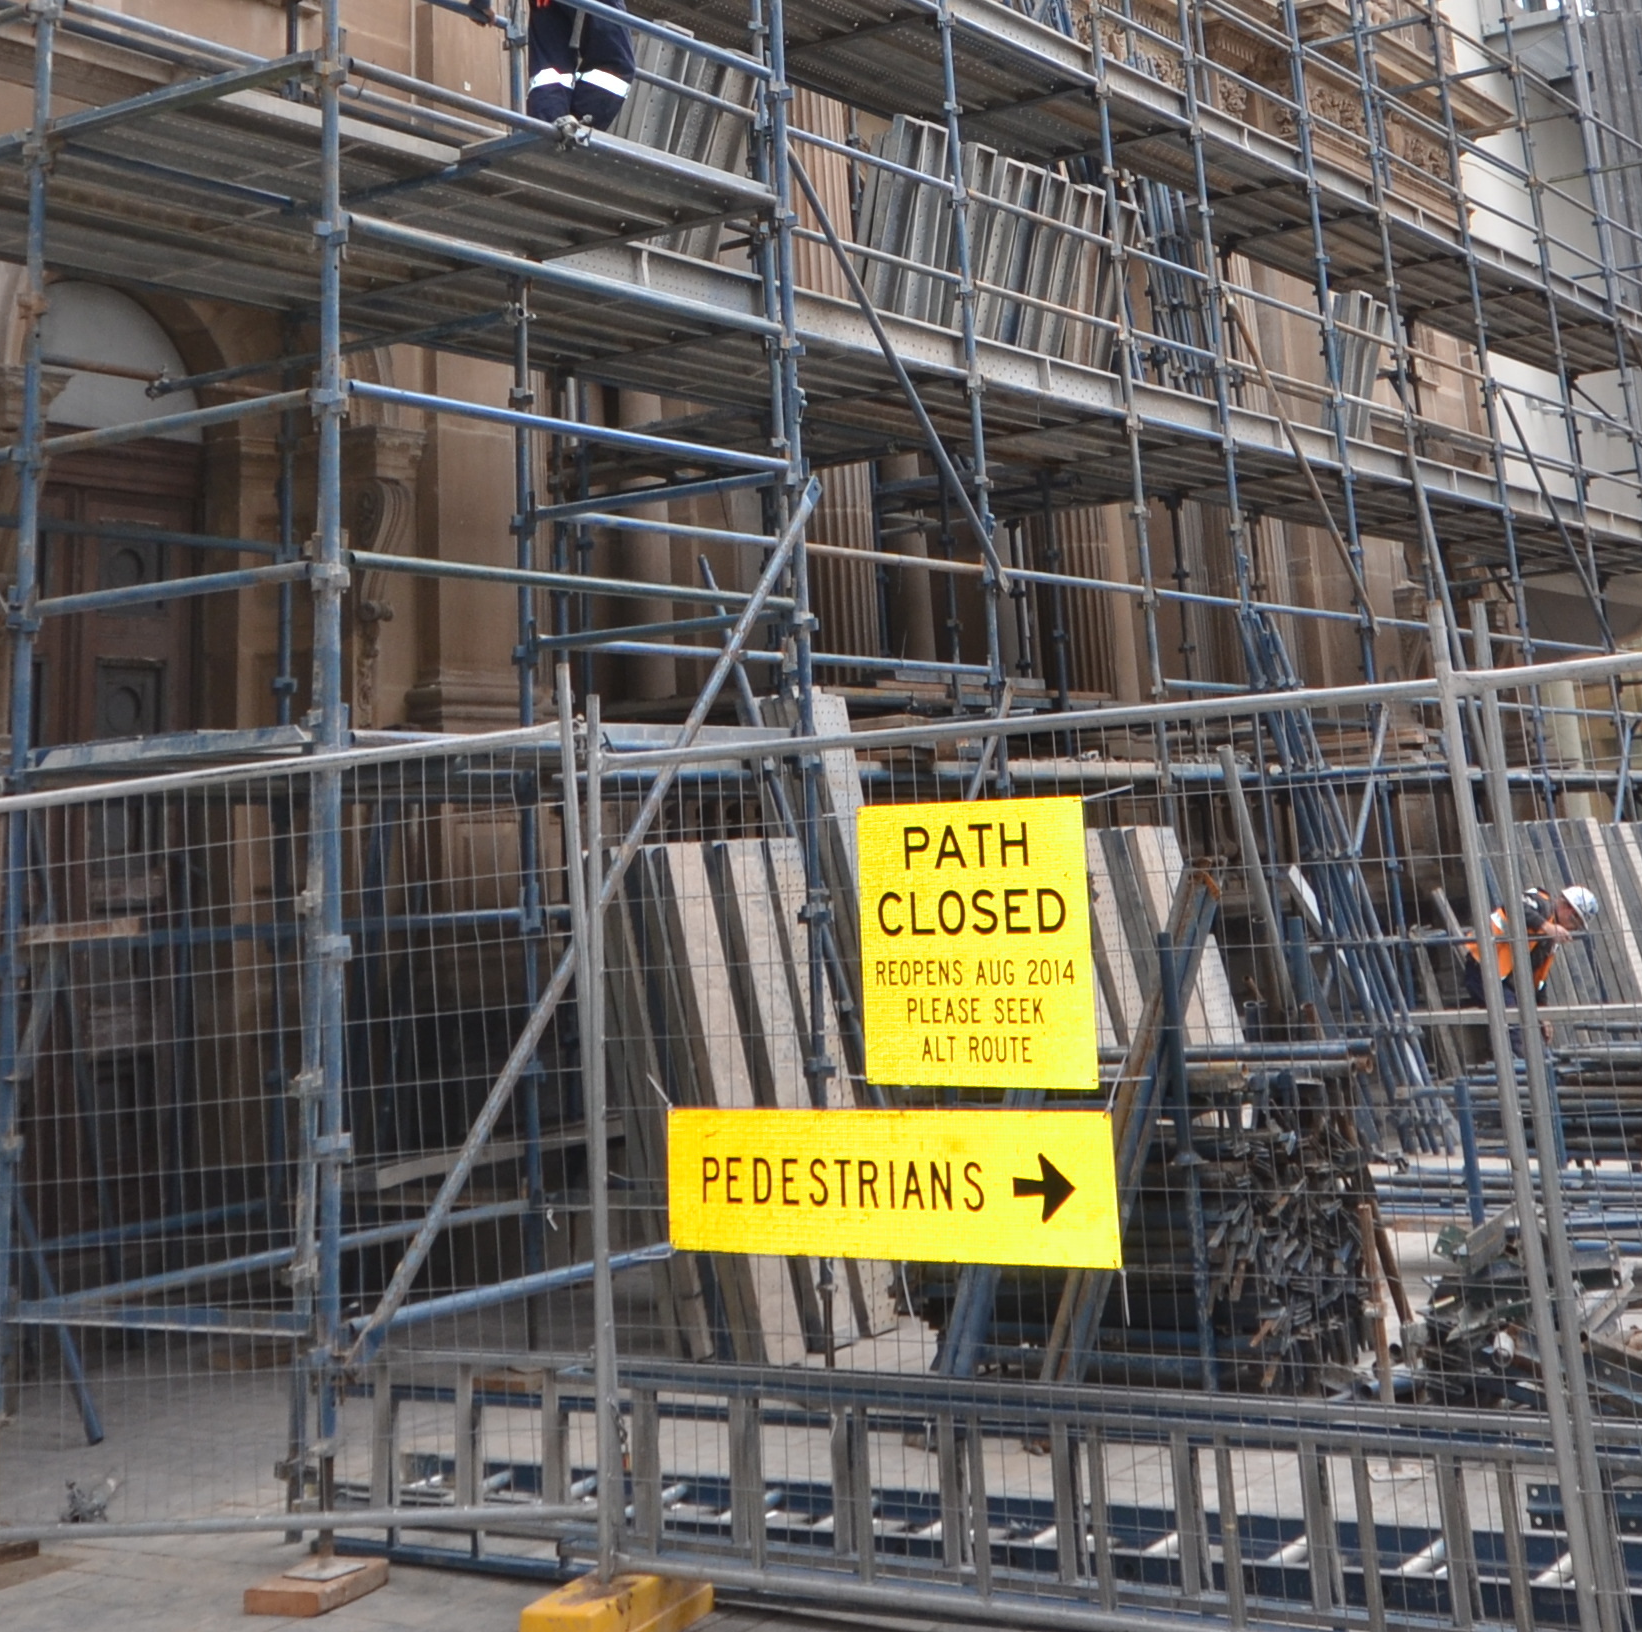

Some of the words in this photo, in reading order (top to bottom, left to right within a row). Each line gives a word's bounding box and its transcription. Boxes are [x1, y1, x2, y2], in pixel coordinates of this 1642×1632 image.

[903, 821, 1030, 870] PATH
[877, 888, 1067, 937] CLOSED
[875, 959, 964, 986] REOPENS
[975, 959, 1015, 986] AUG
[1026, 959, 1076, 985] 2014
[907, 997, 982, 1024] PLEASE
[993, 997, 1045, 1024] SEEK
[922, 1036, 957, 1063] ALT
[967, 1036, 1034, 1063] ROUTE
[702, 1156, 986, 1212] PEDESTRIANS
